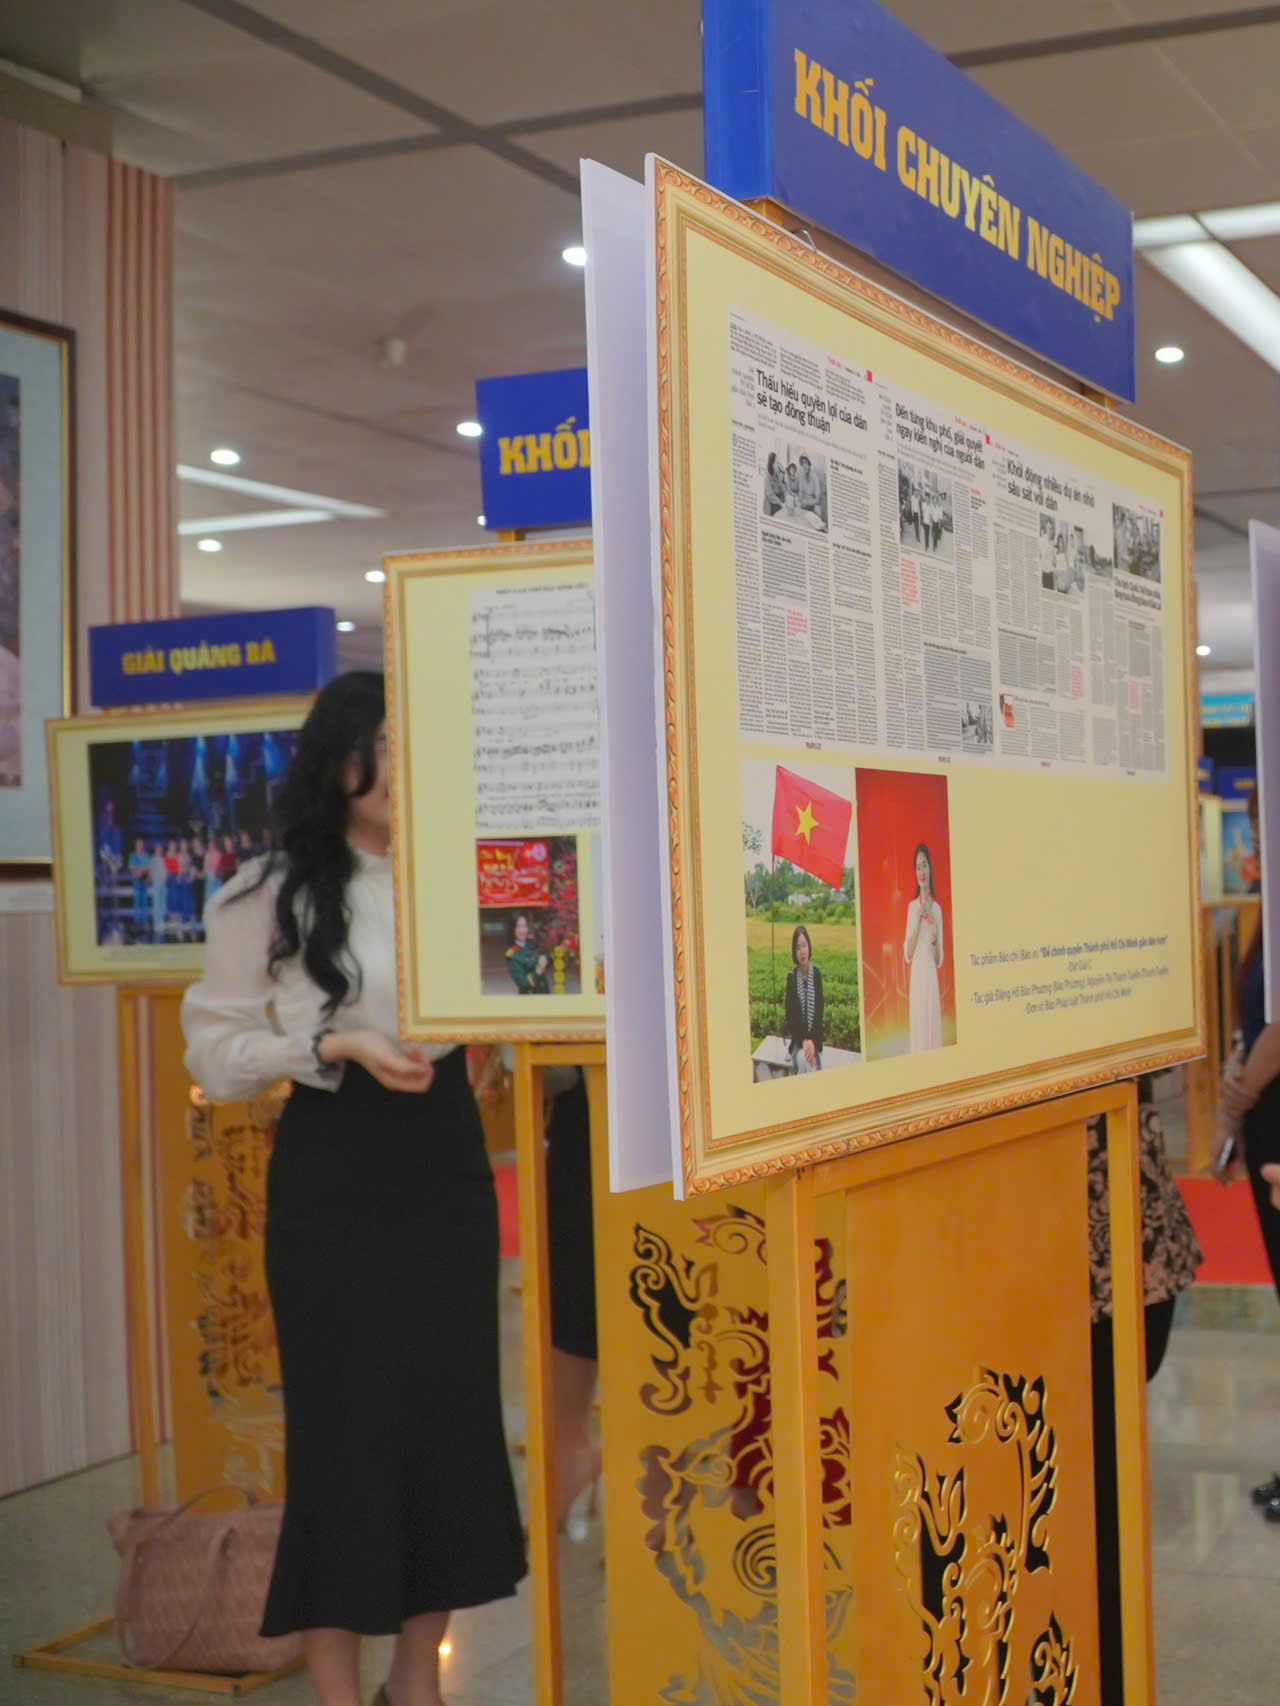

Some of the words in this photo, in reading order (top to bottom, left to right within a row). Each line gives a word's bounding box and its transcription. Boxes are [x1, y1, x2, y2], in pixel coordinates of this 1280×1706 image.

[794, 48, 888, 172] KHỐI
[897, 125, 1021, 261] CHUYÊN
[1027, 215, 1121, 323] NGHIỆP
[499, 416, 591, 475] KHỐI
